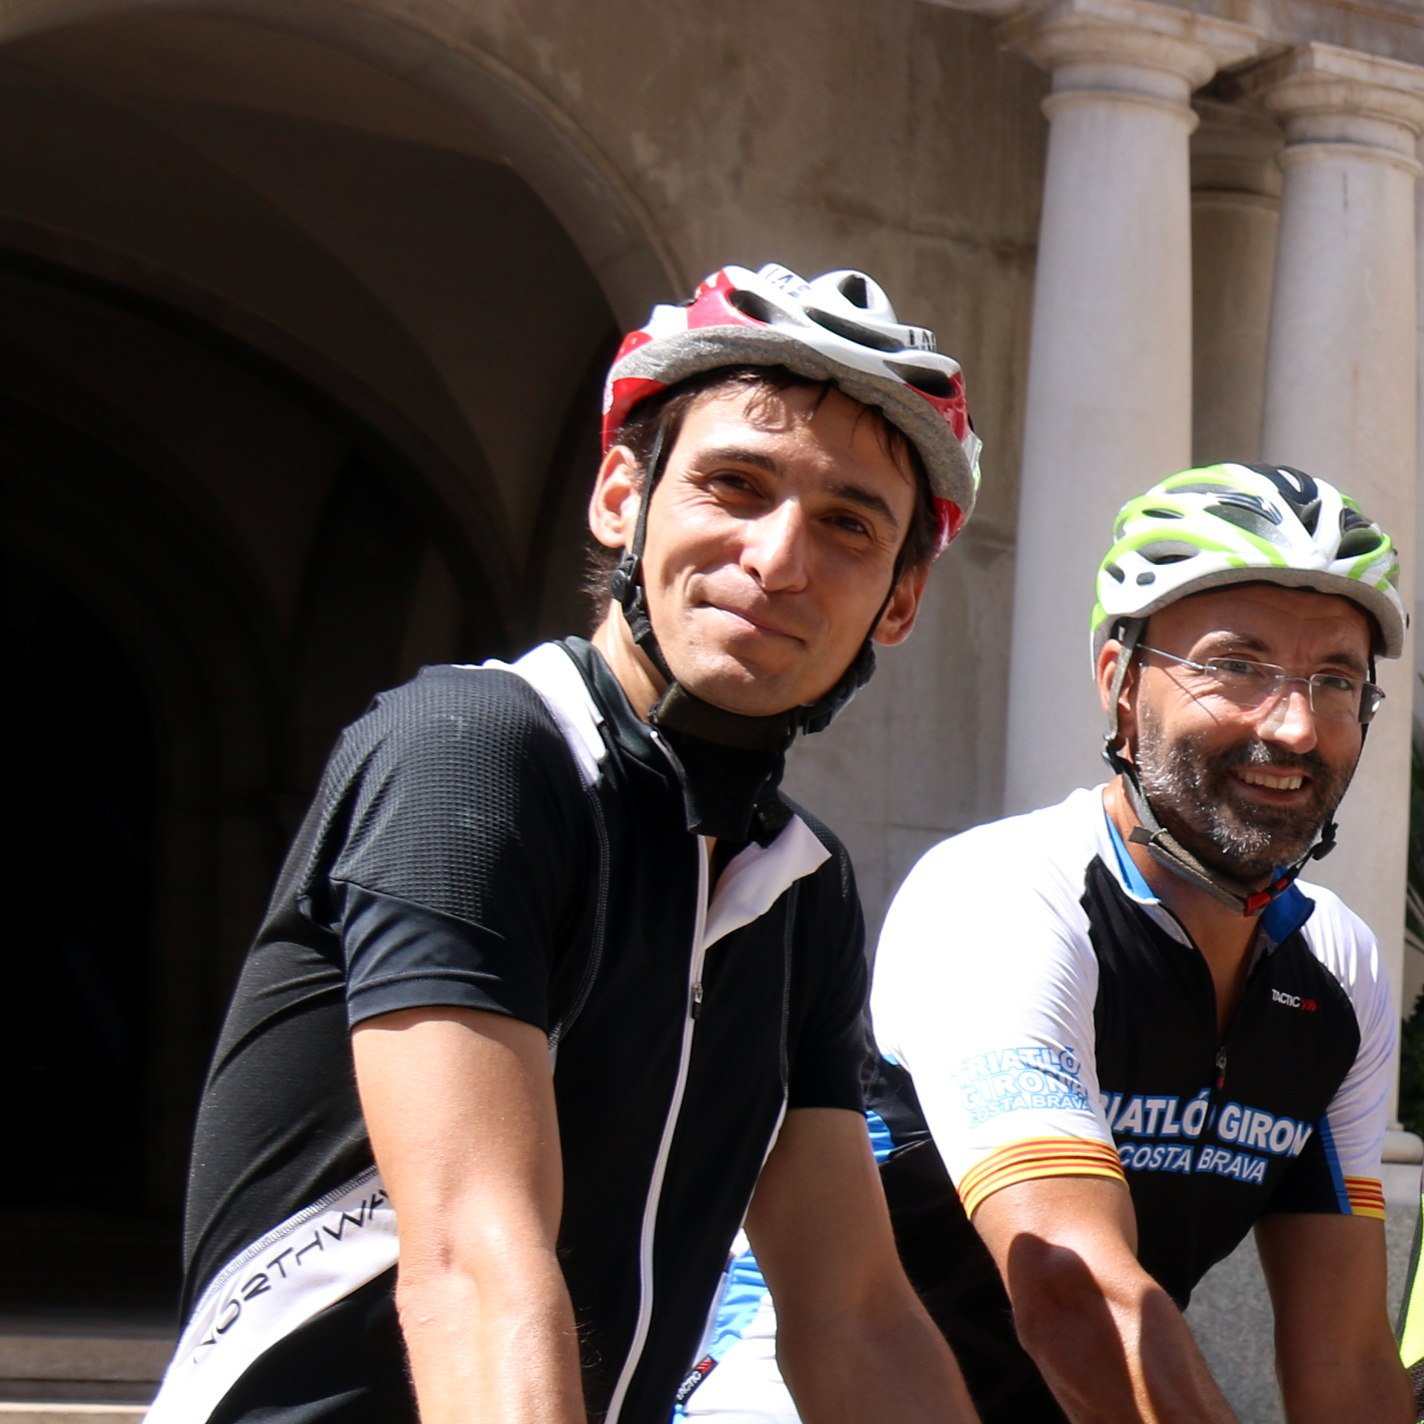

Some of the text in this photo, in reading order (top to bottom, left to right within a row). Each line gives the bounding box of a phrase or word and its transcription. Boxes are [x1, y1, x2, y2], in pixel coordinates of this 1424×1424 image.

[1218, 1104, 1314, 1157] GIRON
[1119, 1144, 1266, 1183] COSTA BRAVA
[193, 1189, 393, 1366] NORTHWA
